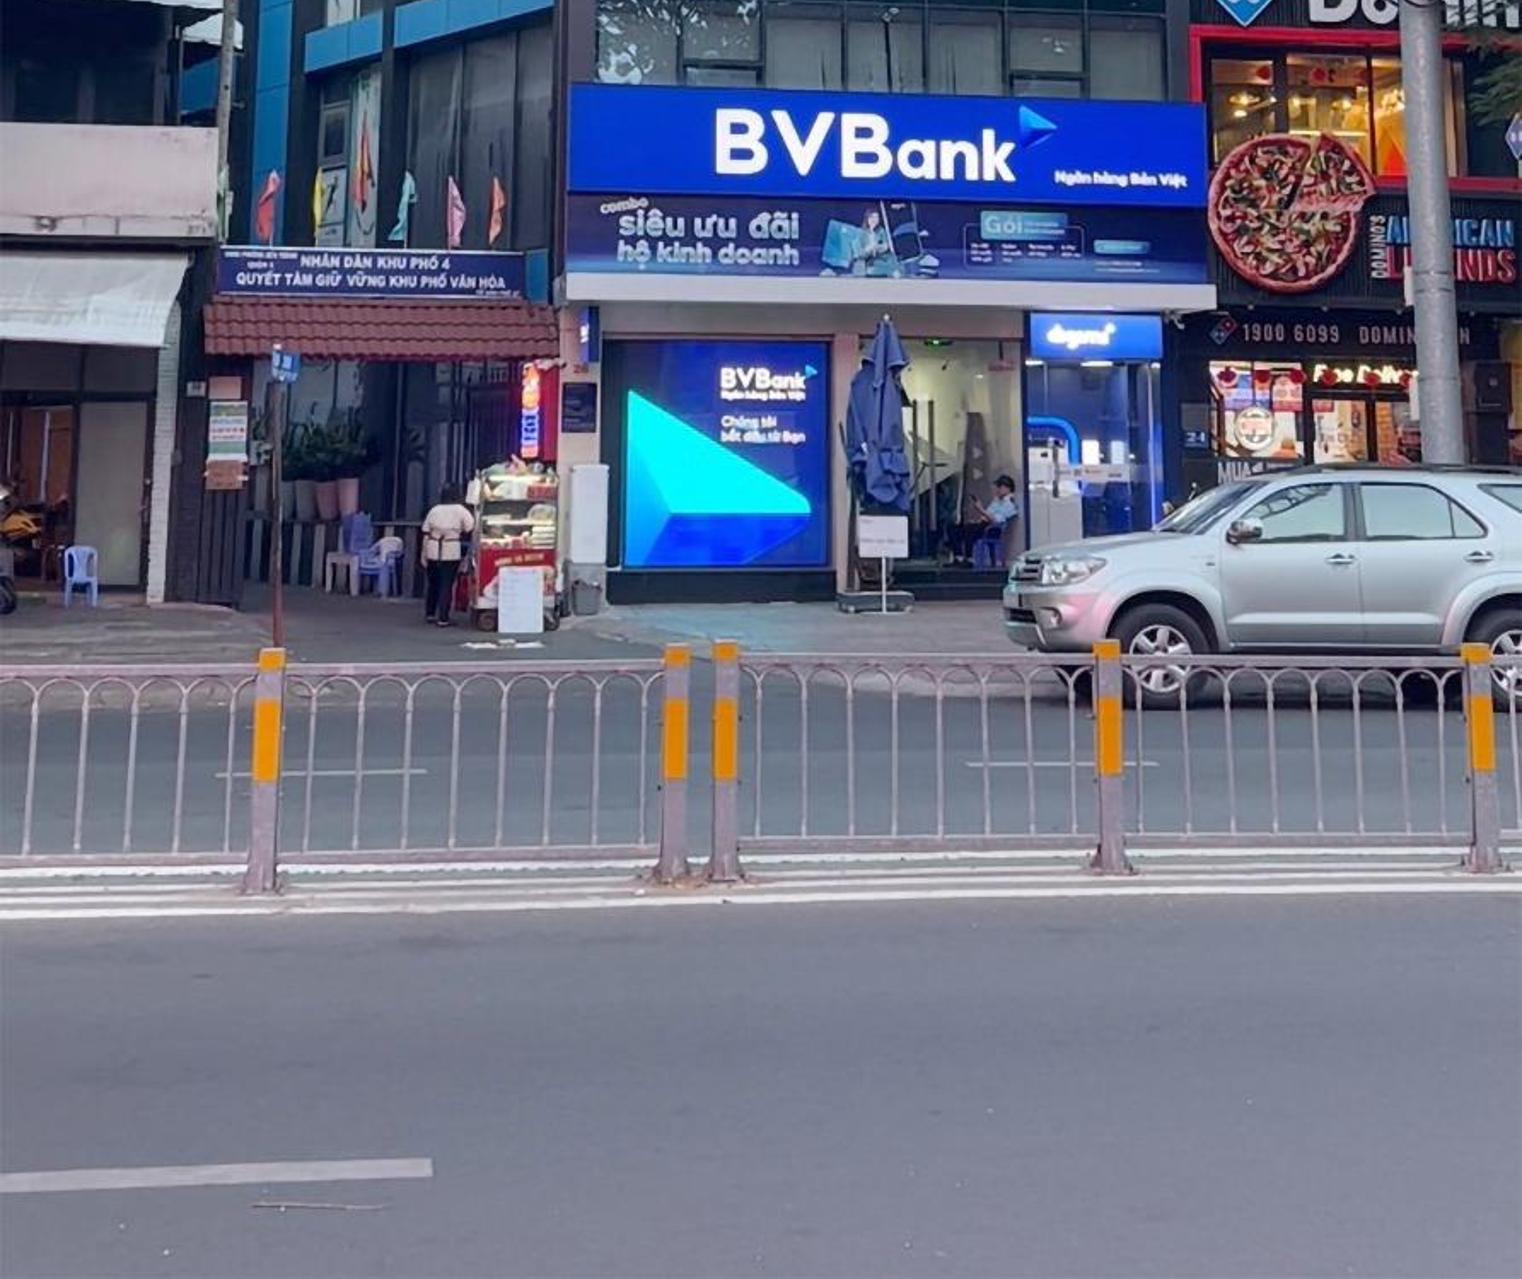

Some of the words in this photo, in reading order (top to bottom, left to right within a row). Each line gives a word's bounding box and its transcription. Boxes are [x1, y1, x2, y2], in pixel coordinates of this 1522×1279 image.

[715, 108, 1017, 183] BVBank
[600, 196, 649, 214] combo
[618, 208, 685, 237] siêu
[694, 213, 737, 239] ưu
[748, 210, 800, 240] đãi
[300, 252, 340, 268] NHÂN
[344, 253, 373, 269] DÂN
[377, 255, 407, 270] KHU
[410, 254, 439, 271] PHỐ
[441, 257, 451, 271] 4
[616, 240, 651, 270] hộ
[656, 241, 712, 264] kinh
[718, 243, 800, 266] doanh
[236, 271, 281, 287] QUYẾT
[389, 275, 418, 289] KHU
[420, 272, 448, 289] PHỐ
[1242, 323, 1284, 342] 1900
[1293, 325, 1340, 343] 6099
[721, 367, 806, 389] BVBank
